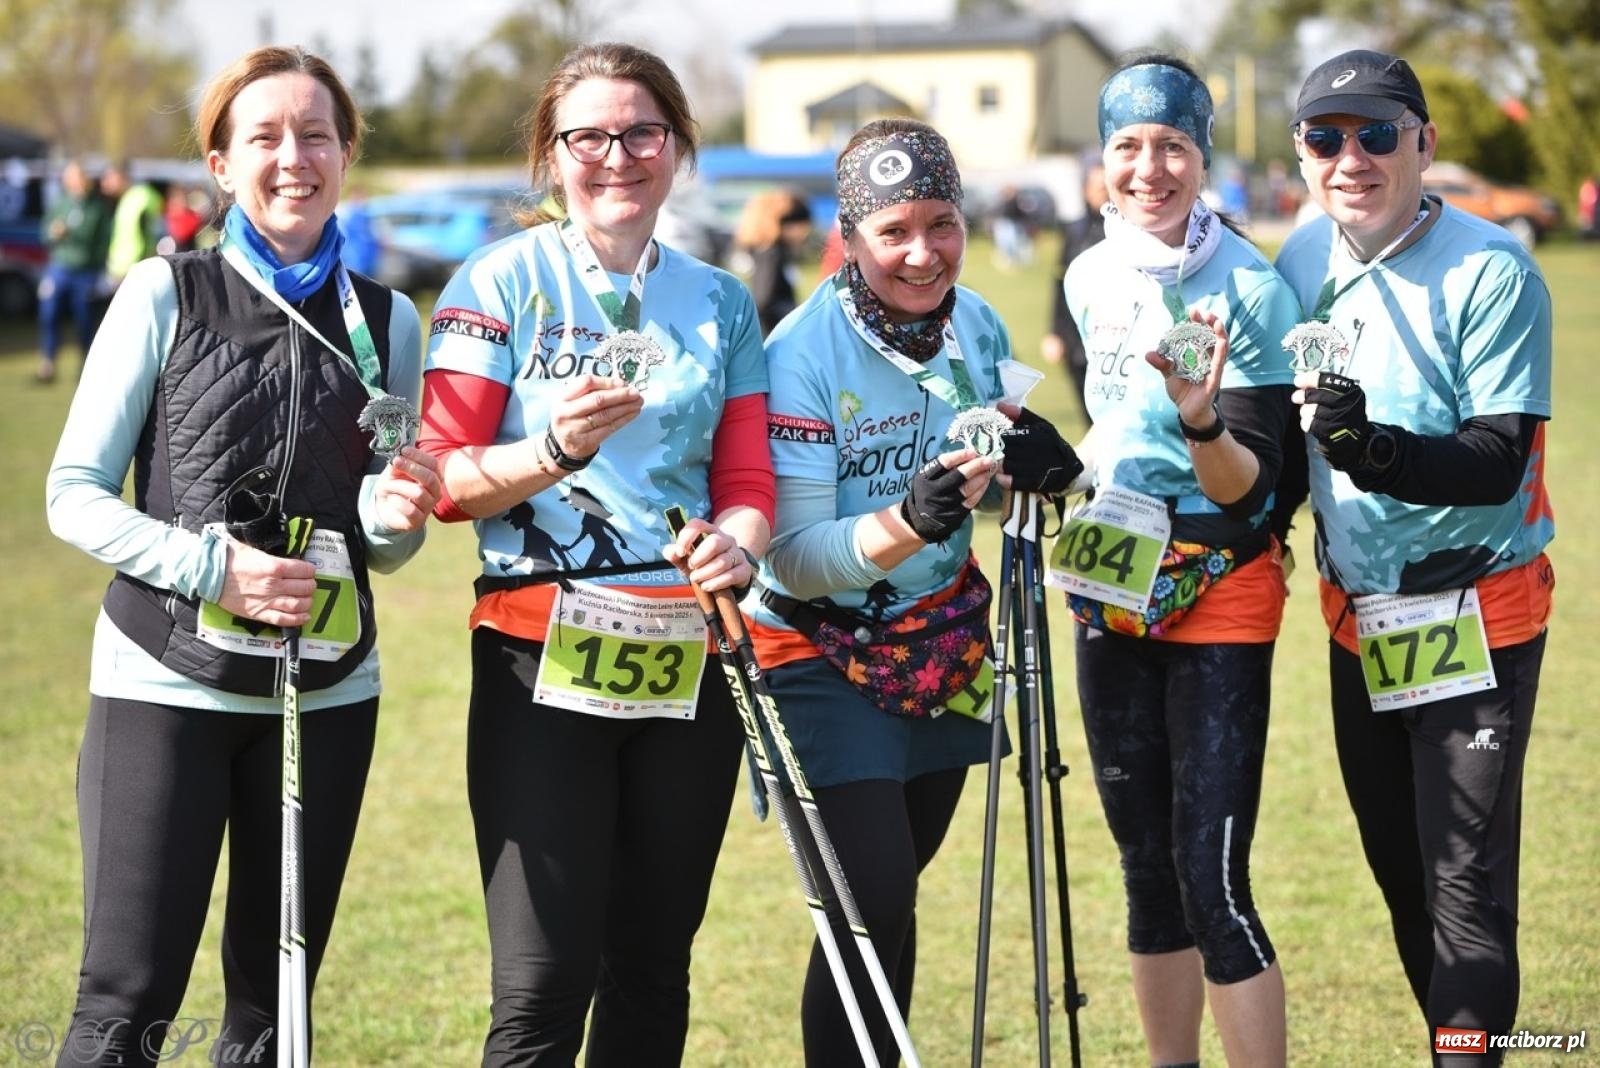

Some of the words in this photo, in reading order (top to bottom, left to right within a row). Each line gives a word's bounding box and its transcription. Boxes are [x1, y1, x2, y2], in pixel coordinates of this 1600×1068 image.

[868, 473, 913, 498] Walk
[1059, 523, 1138, 584] 184
[570, 635, 684, 696] 153
[1368, 624, 1466, 688] 172
